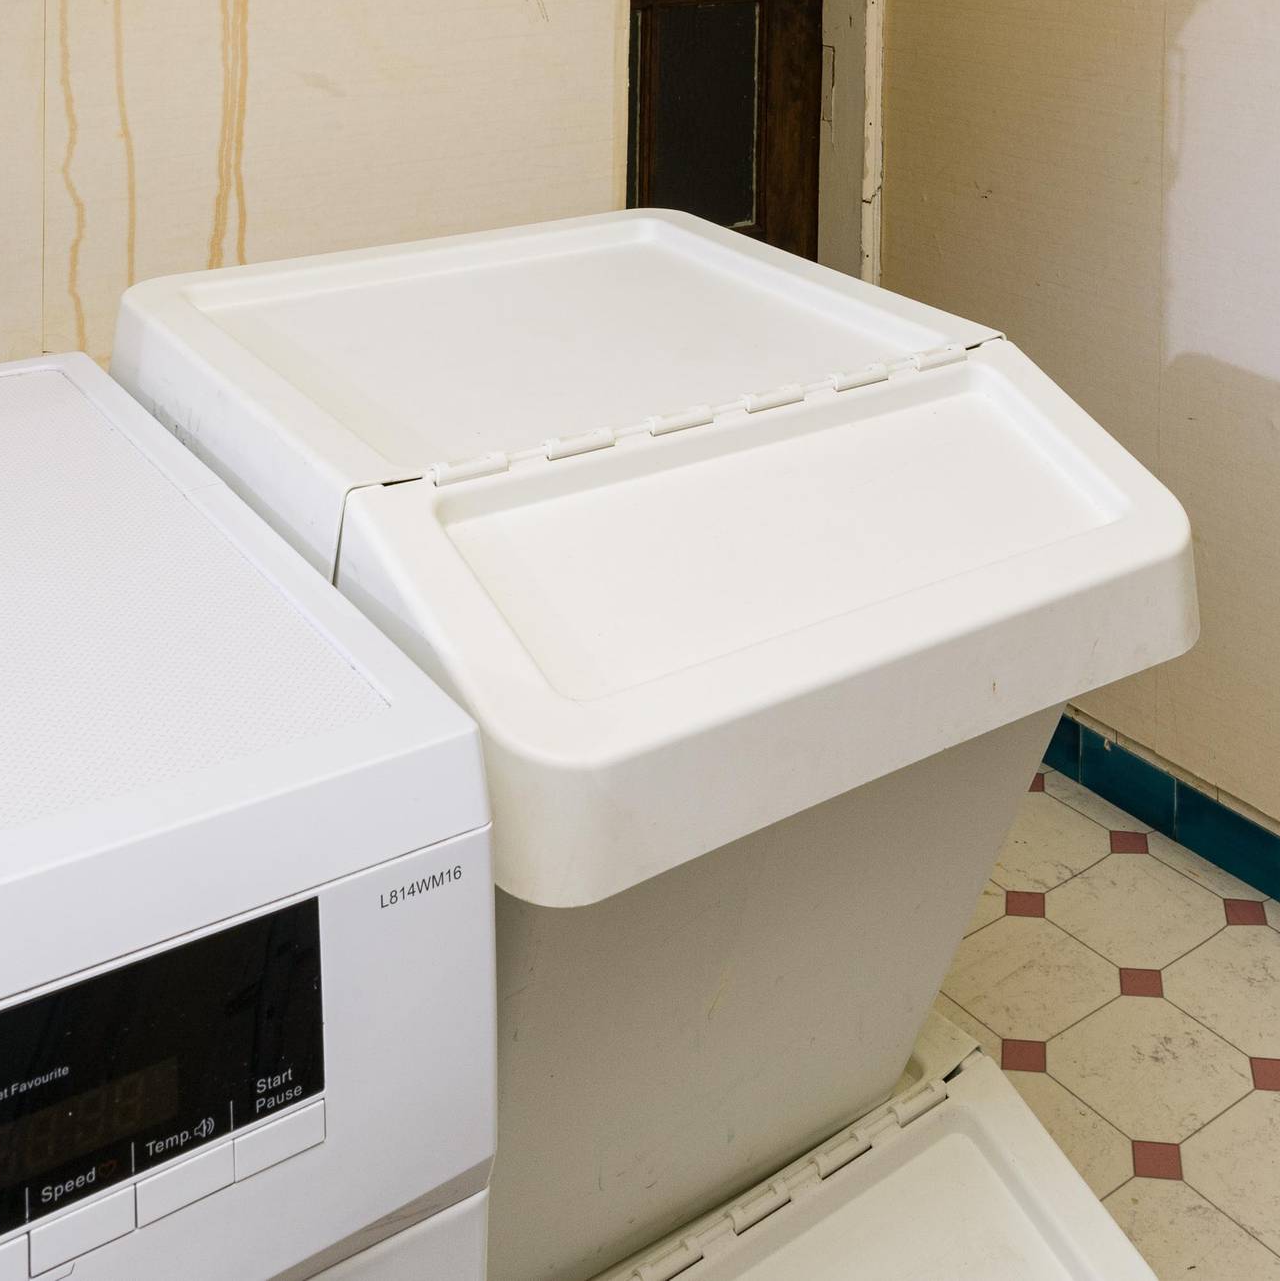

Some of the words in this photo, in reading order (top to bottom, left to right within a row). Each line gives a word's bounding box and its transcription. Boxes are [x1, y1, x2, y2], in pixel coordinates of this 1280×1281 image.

[380, 865, 462, 909] L814WM16
[10, 1065, 70, 1096] Favourite
[256, 1068, 293, 1095] Start
[255, 1084, 303, 1114] Pause
[145, 1129, 193, 1158] Temp.
[41, 1167, 97, 1204] Speed
